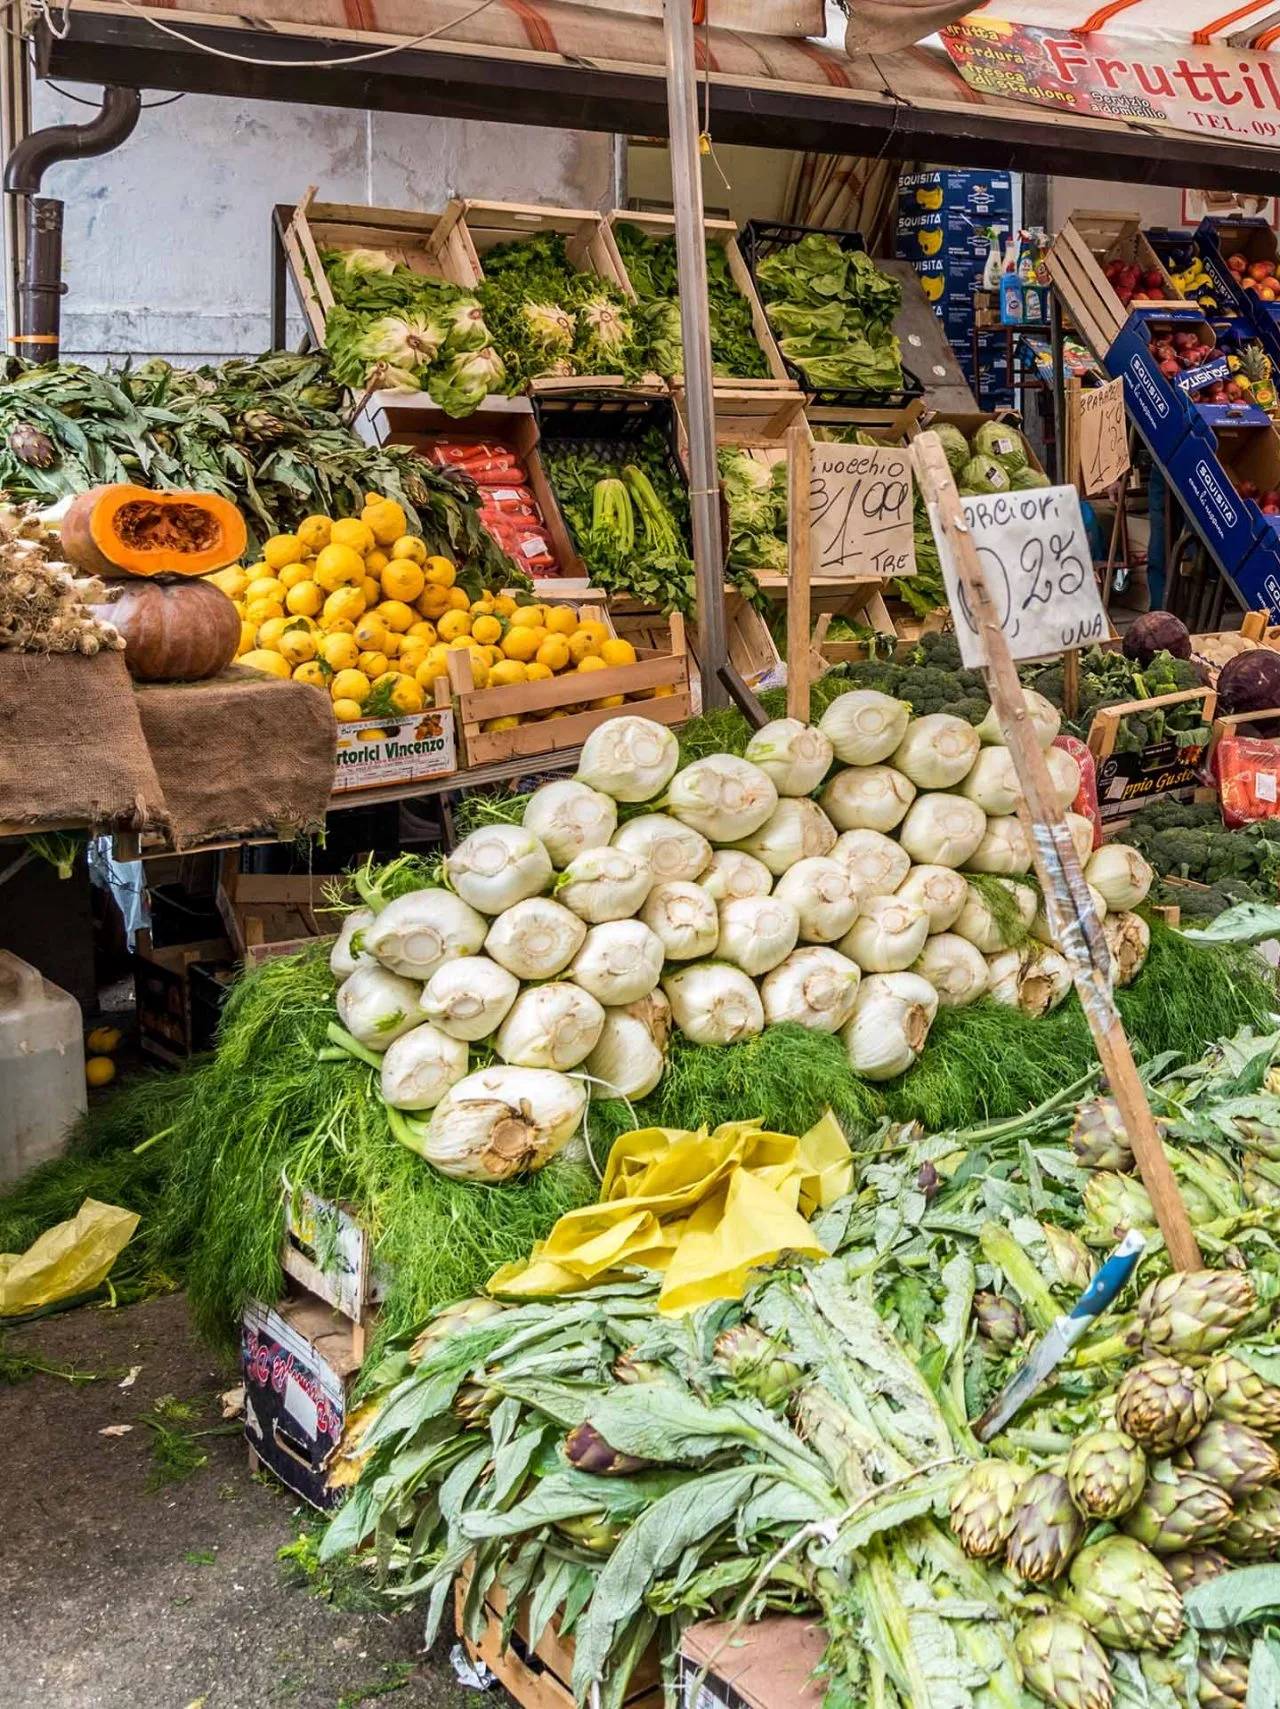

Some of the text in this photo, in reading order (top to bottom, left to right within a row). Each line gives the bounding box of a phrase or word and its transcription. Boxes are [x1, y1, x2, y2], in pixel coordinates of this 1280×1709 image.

[946, 24, 999, 42] frutta
[954, 44, 1024, 64] verdura
[965, 61, 1026, 83] fresca
[974, 74, 1077, 104] di stagione
[1090, 91, 1151, 108] Servizio
[1187, 111, 1248, 134] TEL.
[1061, 613, 1102, 646] UNA
[337, 744, 379, 765] rtorici
[385, 738, 445, 759] Vincenzo
[1156, 769, 1194, 793] Gusto
